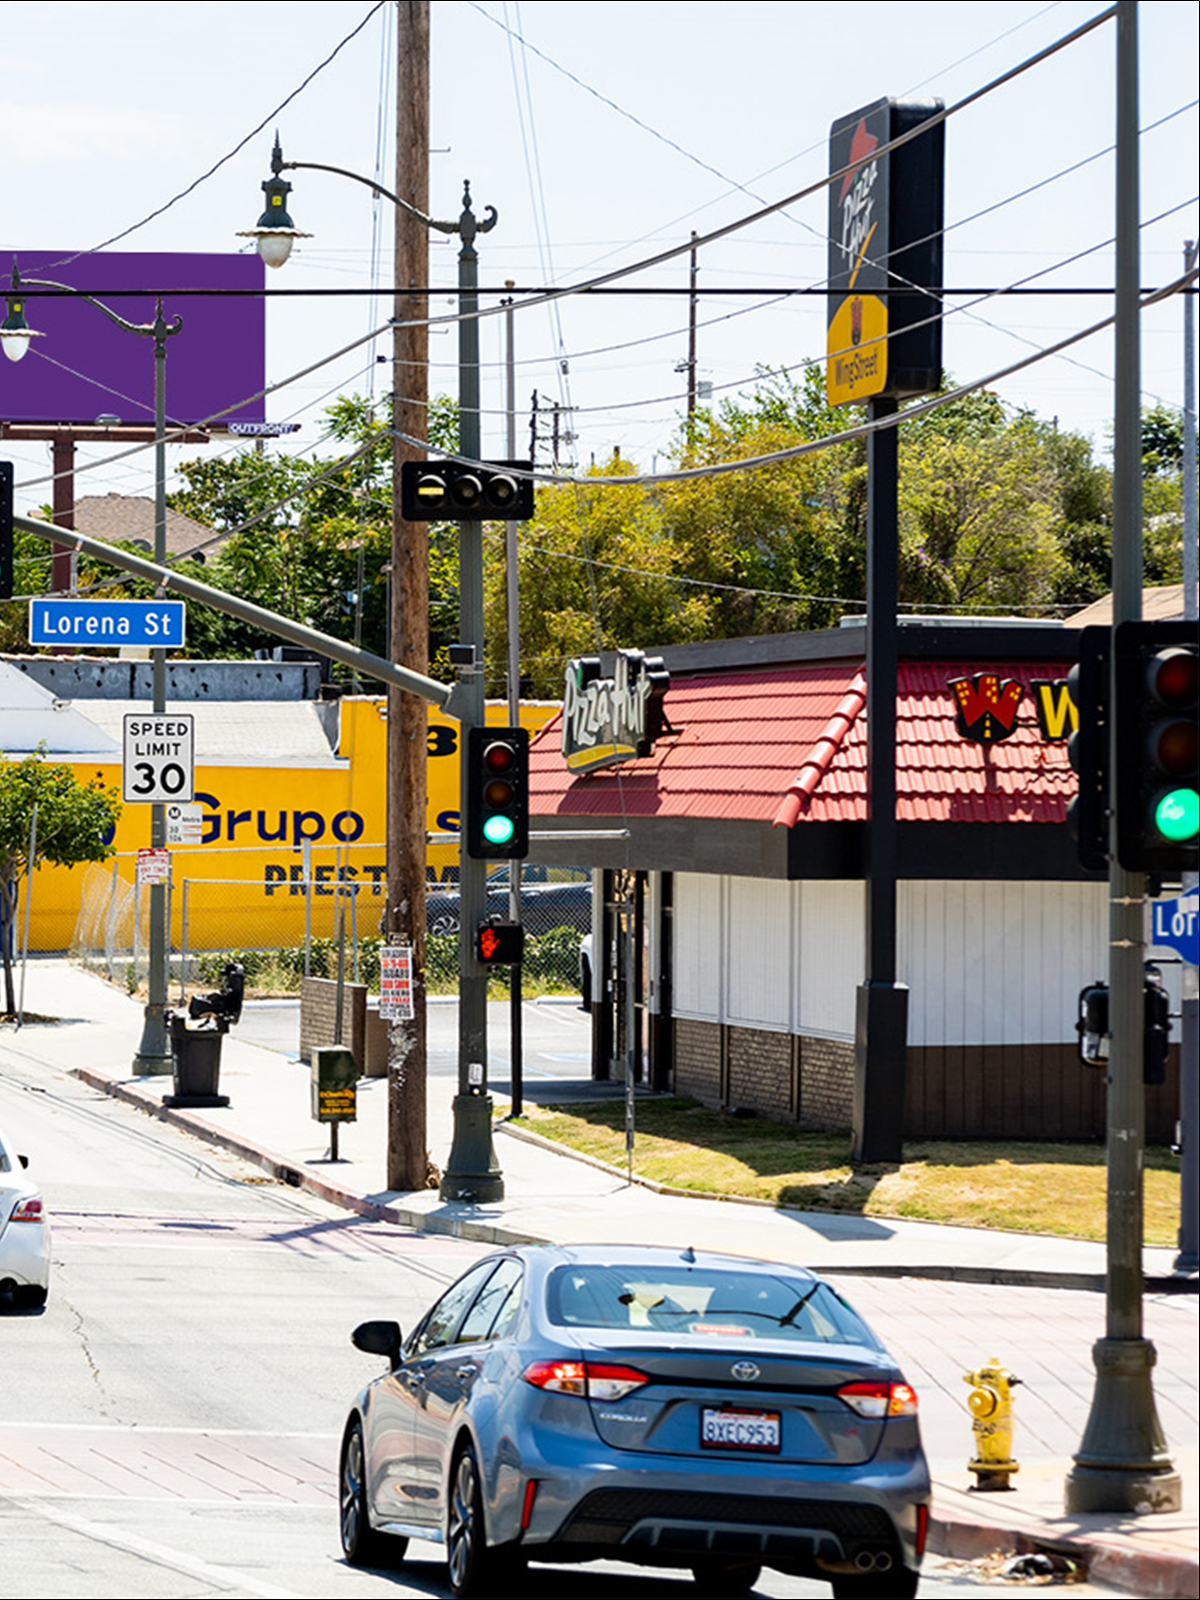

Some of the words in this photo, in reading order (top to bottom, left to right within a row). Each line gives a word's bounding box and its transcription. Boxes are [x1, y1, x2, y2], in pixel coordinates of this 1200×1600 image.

[230, 423, 292, 434] OUTFRONT
[43, 610, 130, 635] Lorena
[144, 611, 171, 636] St
[562, 666, 612, 753] Pizza
[611, 657, 652, 736] Hut
[130, 722, 188, 736] SPEED
[135, 743, 181, 757] LIMIT
[131, 763, 186, 795] 30
[194, 792, 364, 852] Grupo
[1157, 905, 1197, 937] Lor
[706, 1421, 776, 1446] 8XEC953
